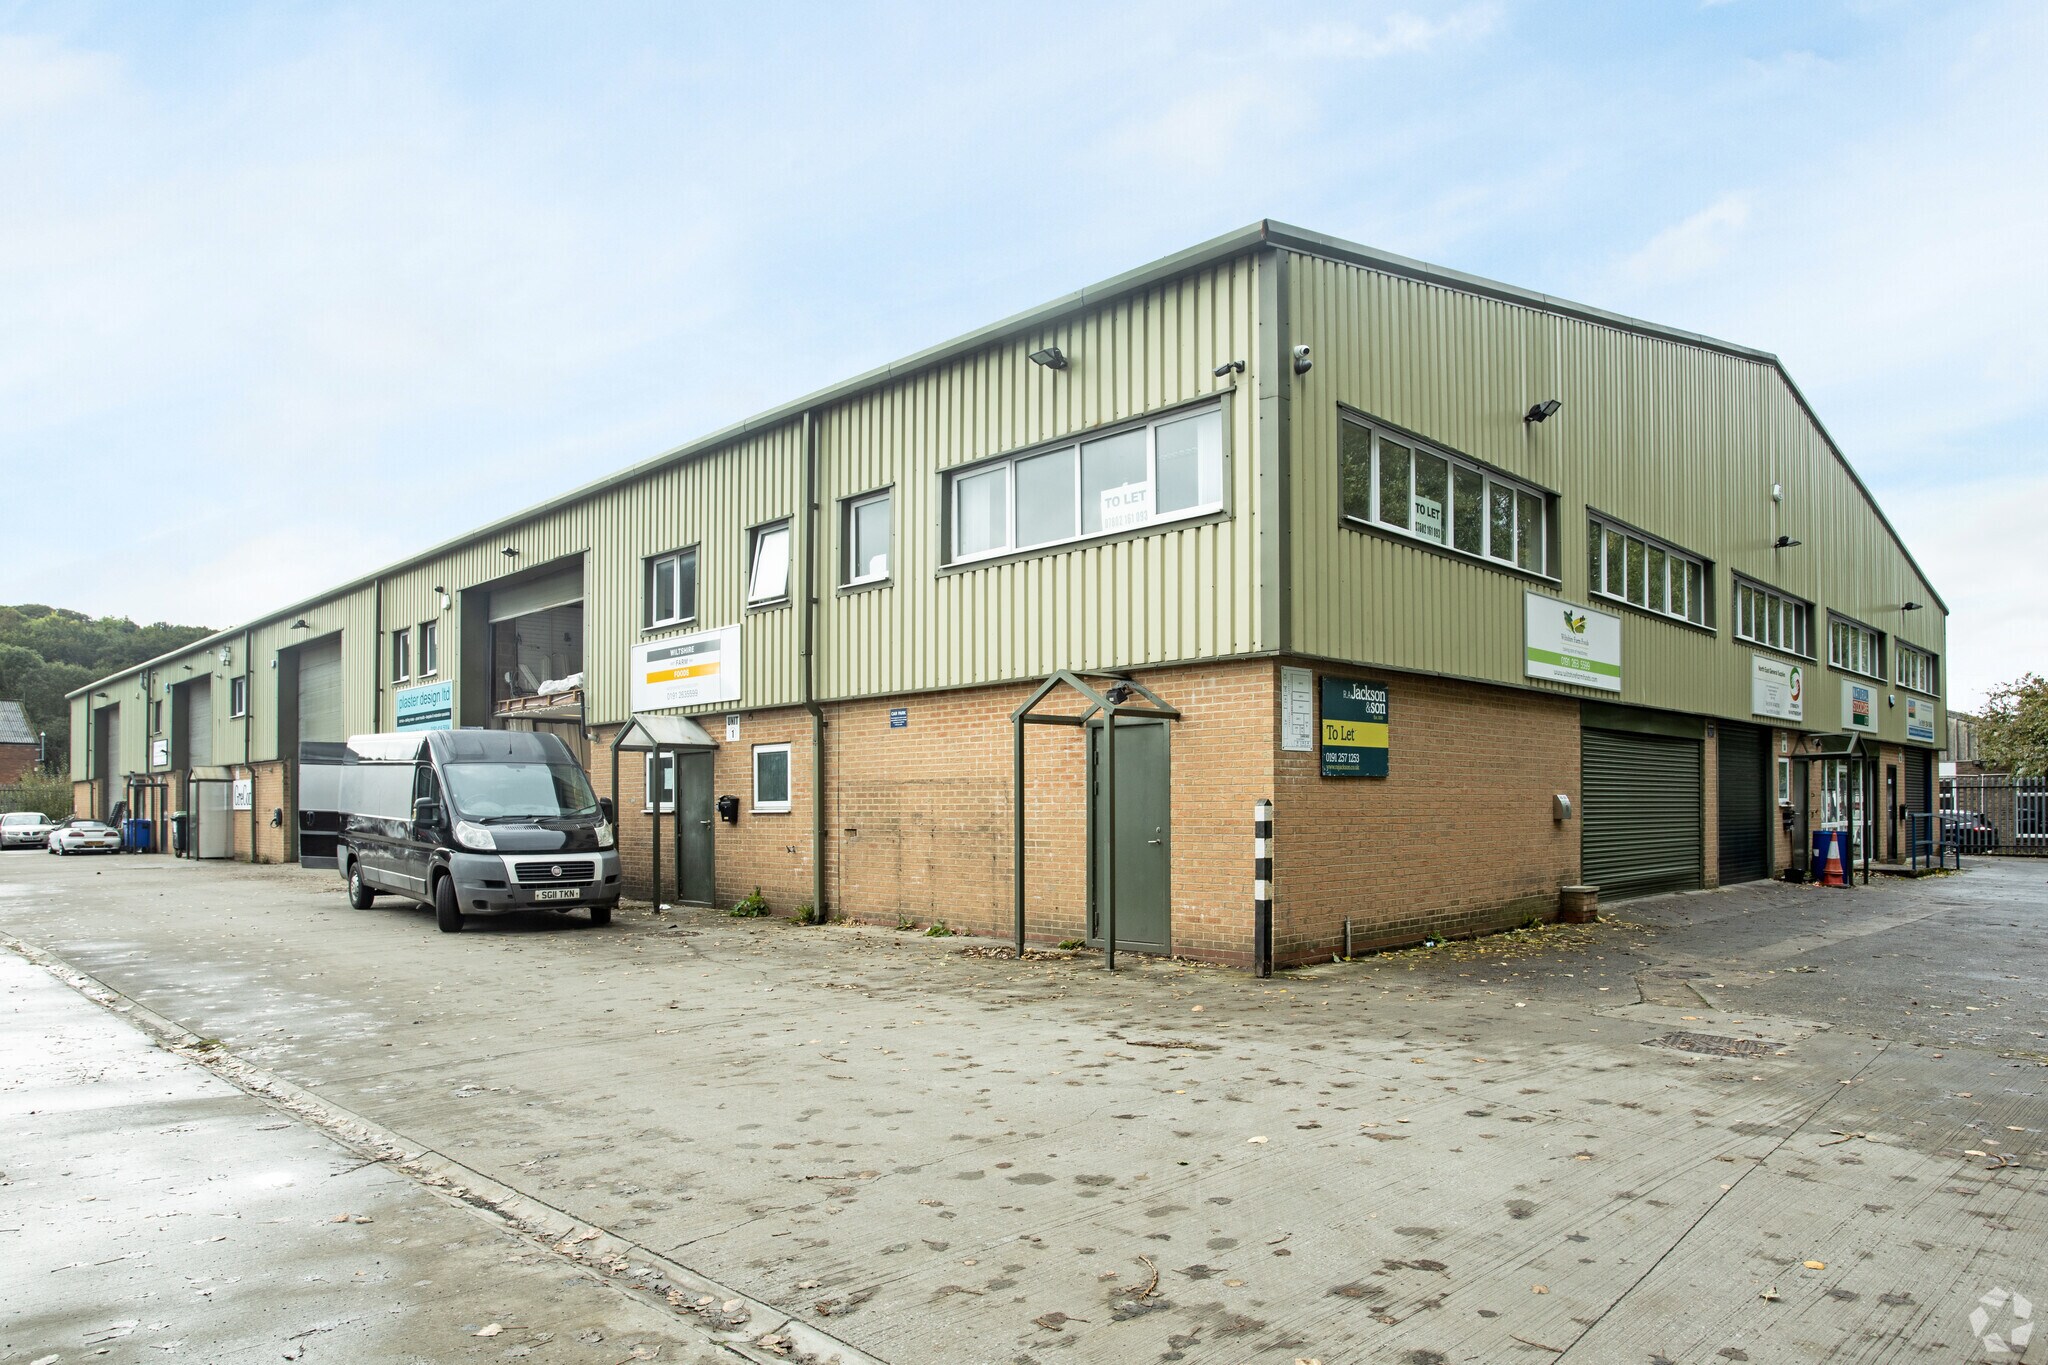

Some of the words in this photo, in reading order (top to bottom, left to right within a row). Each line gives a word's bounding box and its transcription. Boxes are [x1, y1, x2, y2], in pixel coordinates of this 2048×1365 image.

[1105, 496, 1120, 508] TO
[1124, 490, 1146, 504] LET
[1415, 503, 1425, 515] TO
[1427, 507, 1440, 520] LET
[670, 646, 695, 657] WILTSHIRE
[676, 658, 688, 666] FARM
[1560, 656, 1570, 666] 0191
[674, 669, 689, 677] FOODS
[667, 691, 678, 700] 0191
[1351, 684, 1386, 703] Jackson
[399, 693, 419, 712] plaster
[420, 690, 440, 707] design
[442, 687, 450, 701] ltd
[728, 716, 738, 725] UNIT
[1326, 725, 1338, 740] To
[1340, 726, 1355, 741] Let
[1325, 752, 1337, 762] 0191
[1338, 753, 1347, 763] 257
[1348, 753, 1359, 763] 1253
[542, 891, 557, 899] SG11
[559, 890, 575, 898] TKN
